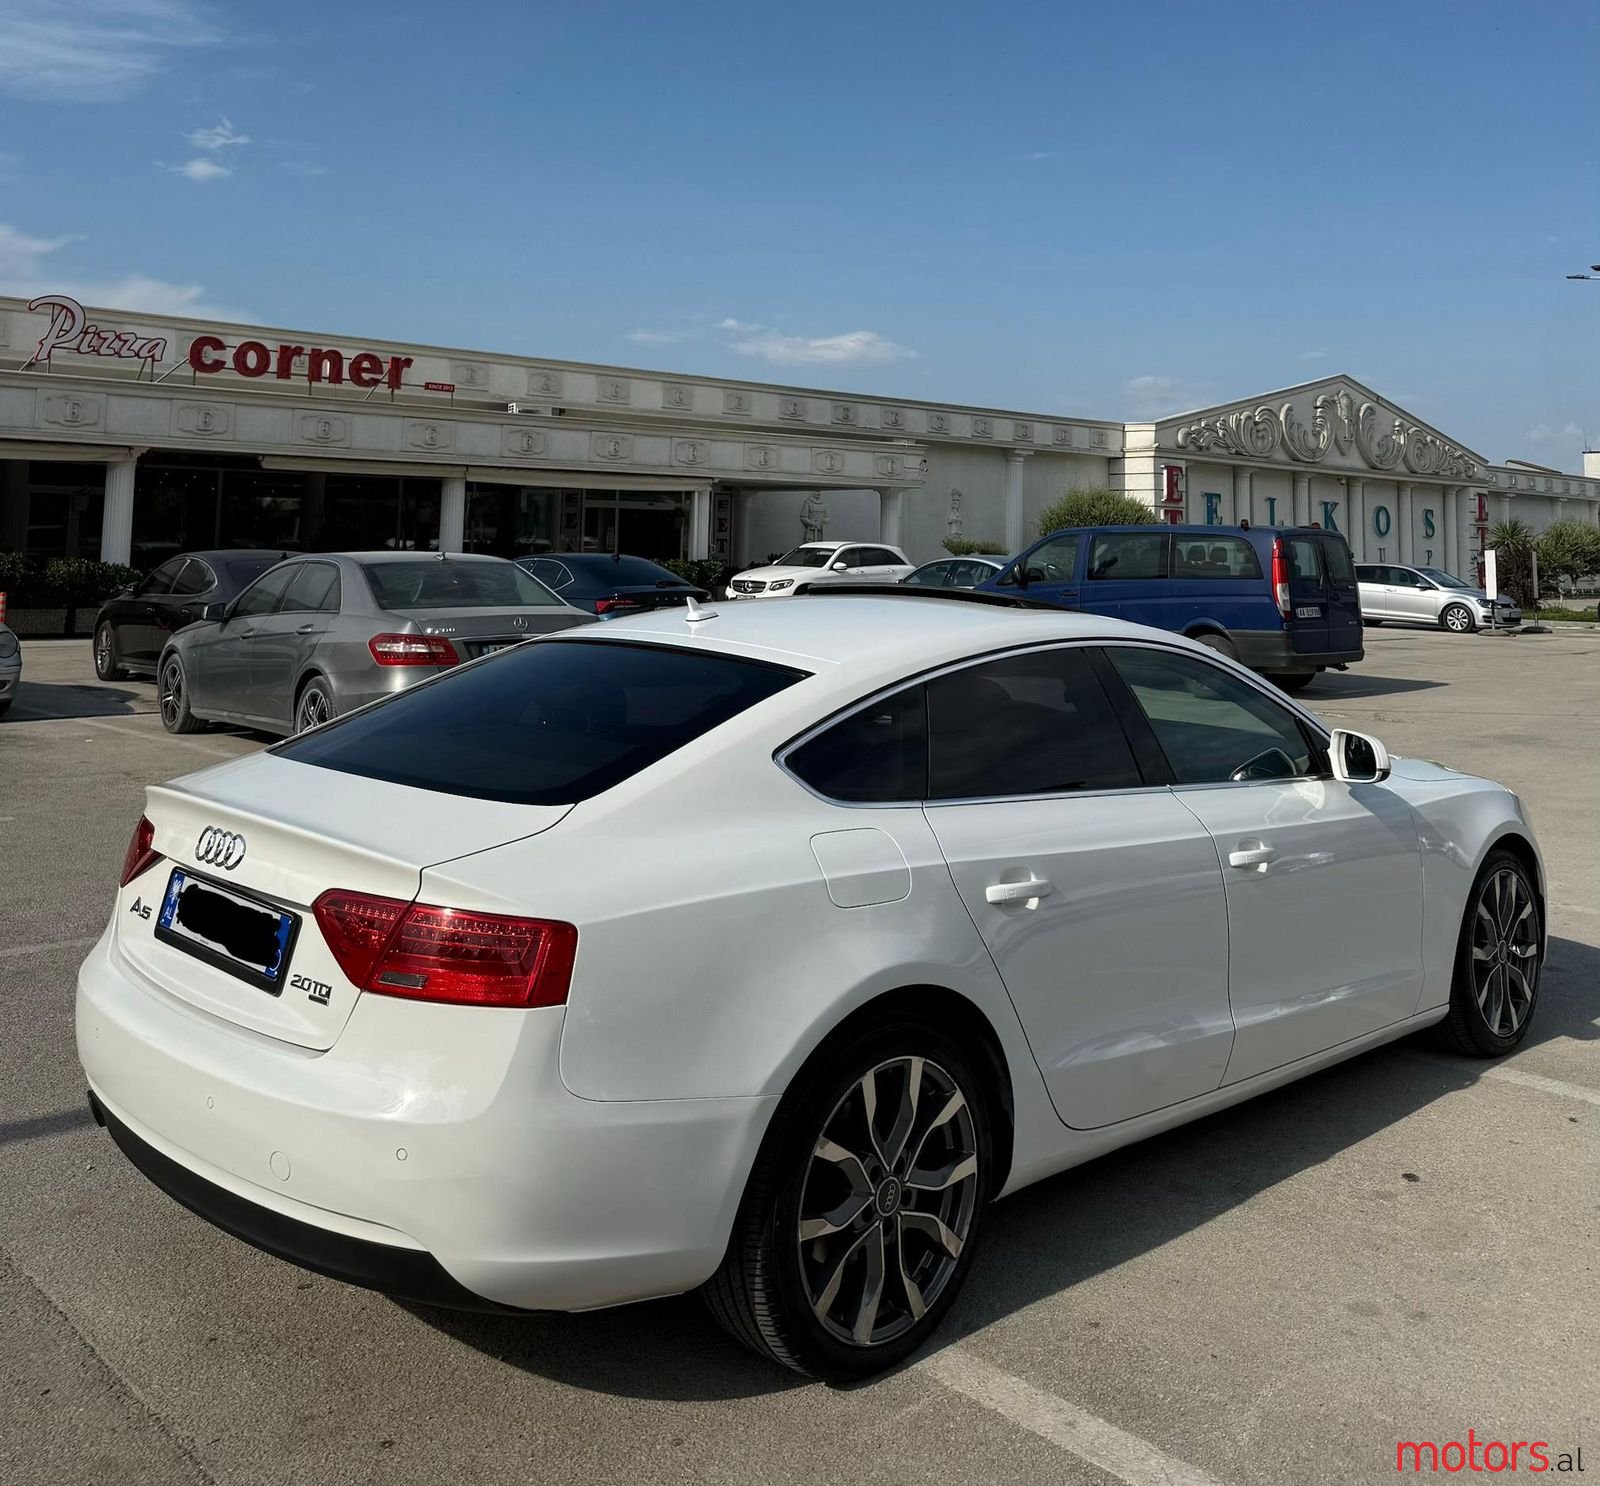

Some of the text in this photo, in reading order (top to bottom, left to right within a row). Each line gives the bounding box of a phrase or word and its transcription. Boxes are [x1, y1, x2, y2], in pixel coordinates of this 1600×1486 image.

[28, 295, 414, 390] Pizza corner
[130, 896, 152, 920] A5
